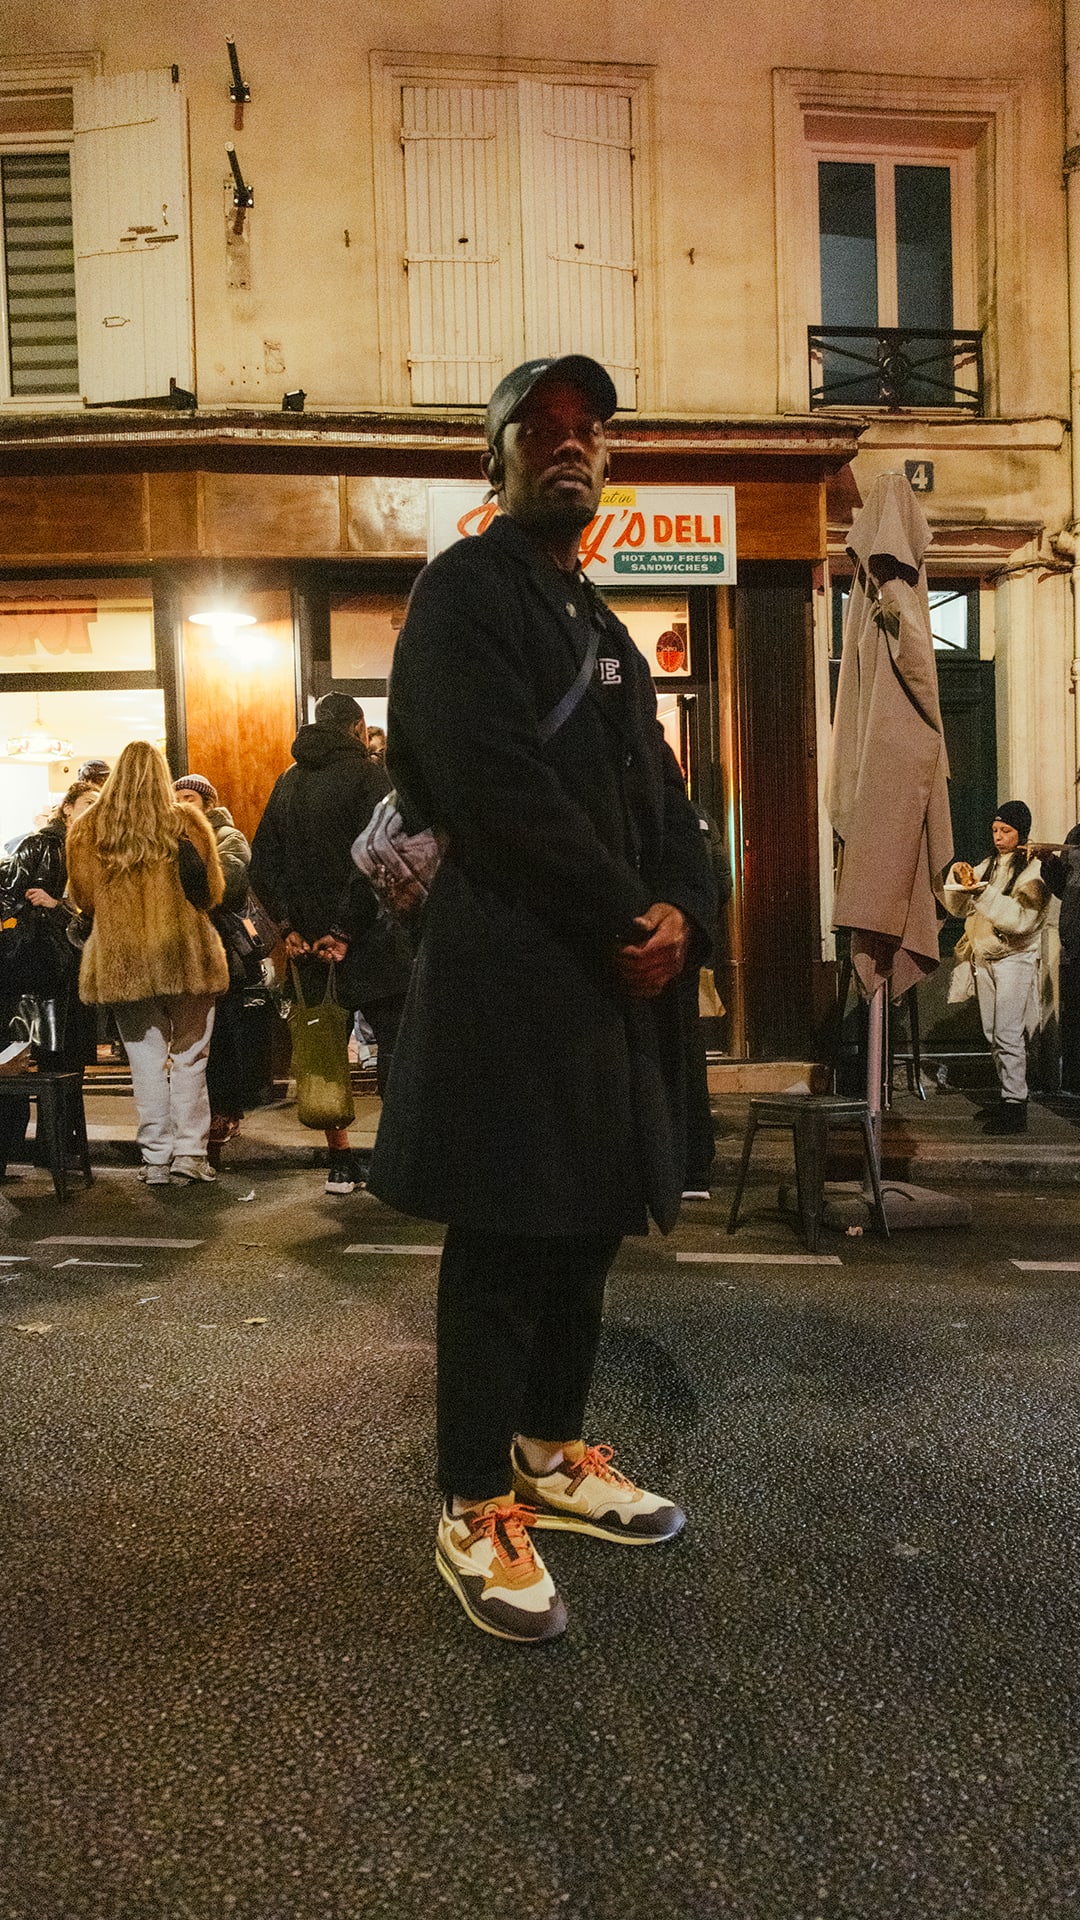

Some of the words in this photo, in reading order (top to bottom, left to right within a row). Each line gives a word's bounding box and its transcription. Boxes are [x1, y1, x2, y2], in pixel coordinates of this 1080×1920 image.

[911, 464, 928, 489] 4
[619, 494, 632, 503] in
[653, 515, 721, 543] DELI
[631, 563, 709, 571] SANDWICHES
